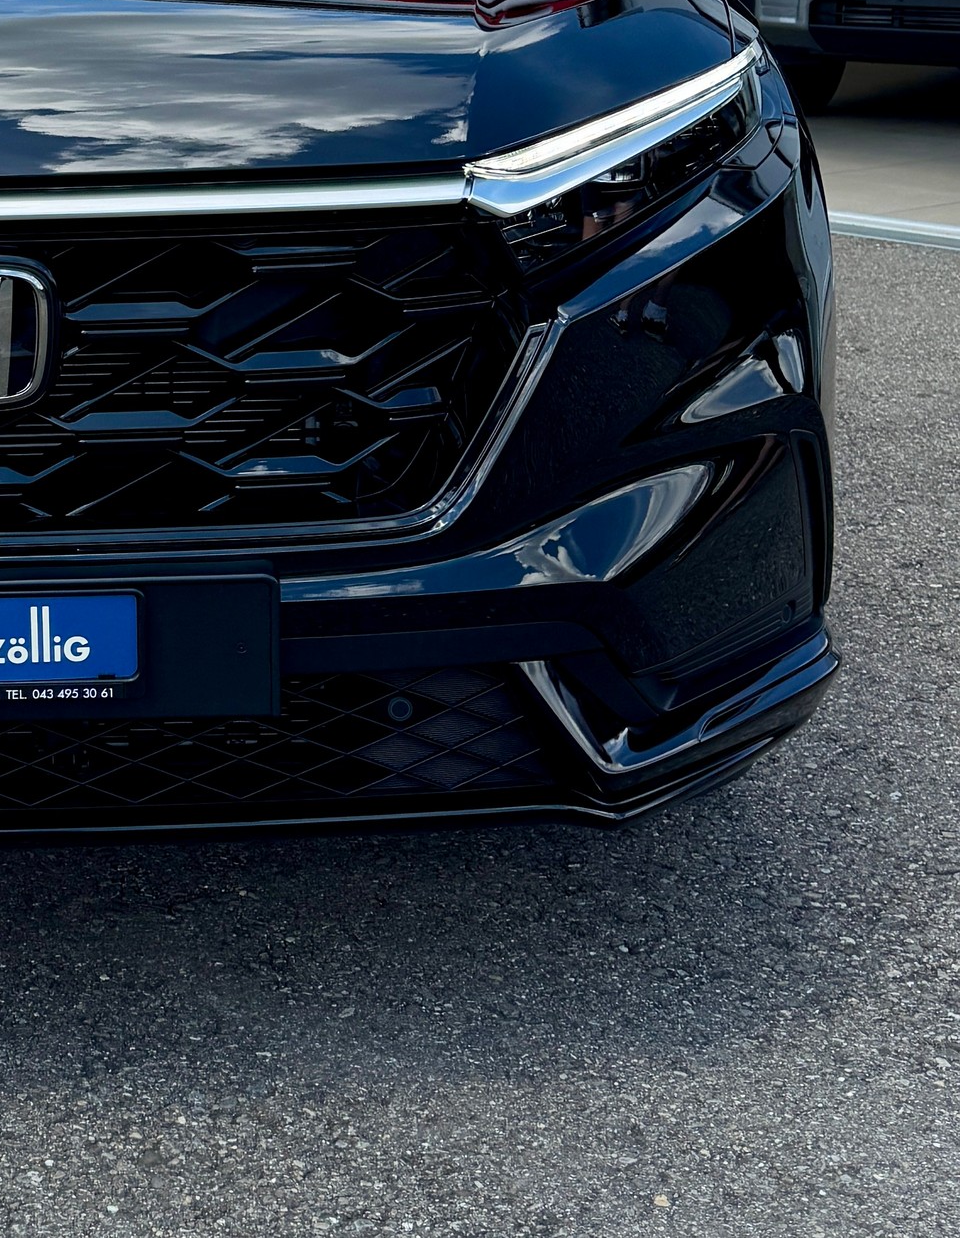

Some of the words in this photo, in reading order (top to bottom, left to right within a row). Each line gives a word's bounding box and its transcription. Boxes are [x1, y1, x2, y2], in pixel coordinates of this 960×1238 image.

[6, 689, 27, 700] TEL.
[32, 689, 54, 699] 043
[57, 688, 79, 699] 495
[82, 688, 97, 699] 30
[100, 687, 114, 699] 61
